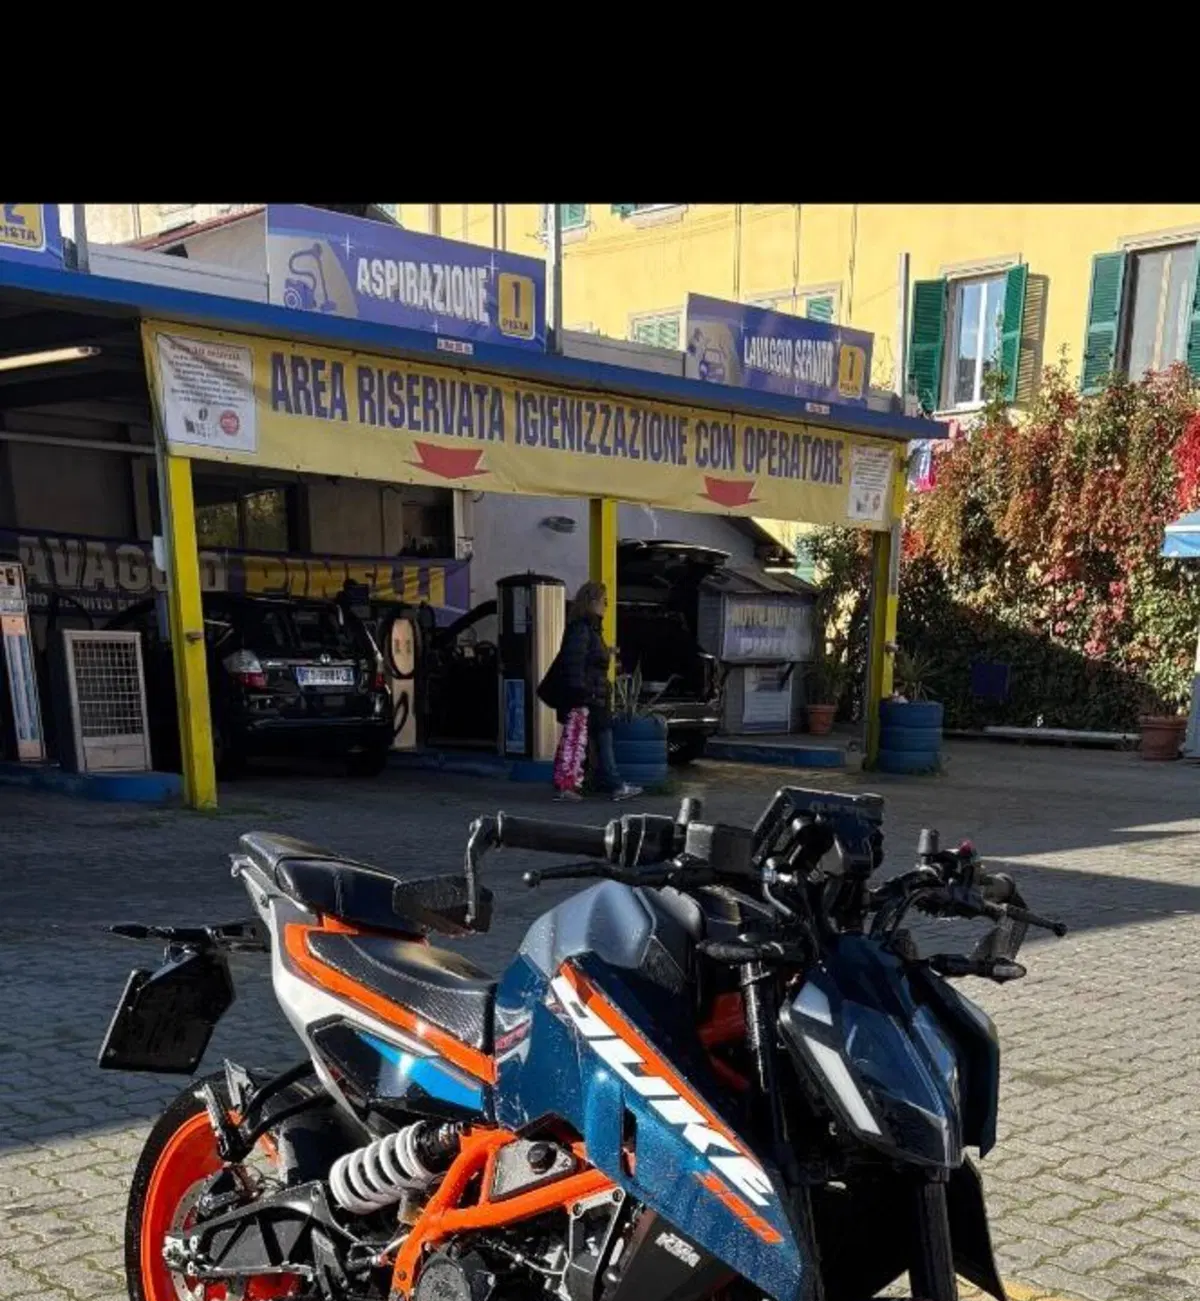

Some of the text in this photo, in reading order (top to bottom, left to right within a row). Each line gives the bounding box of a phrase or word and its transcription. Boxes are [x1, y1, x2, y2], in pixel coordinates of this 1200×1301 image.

[357, 258, 490, 325] ASPIRAZIONE
[512, 281, 521, 318] 1
[743, 336, 793, 377] LAVAGGIO
[271, 351, 348, 422] AREA
[357, 365, 505, 442] RISERVATA
[514, 390, 688, 466] IGIENIZZAZIONE
[695, 419, 735, 470] CON
[743, 426, 844, 485] OPERATORE
[551, 975, 774, 1206] DUKE
